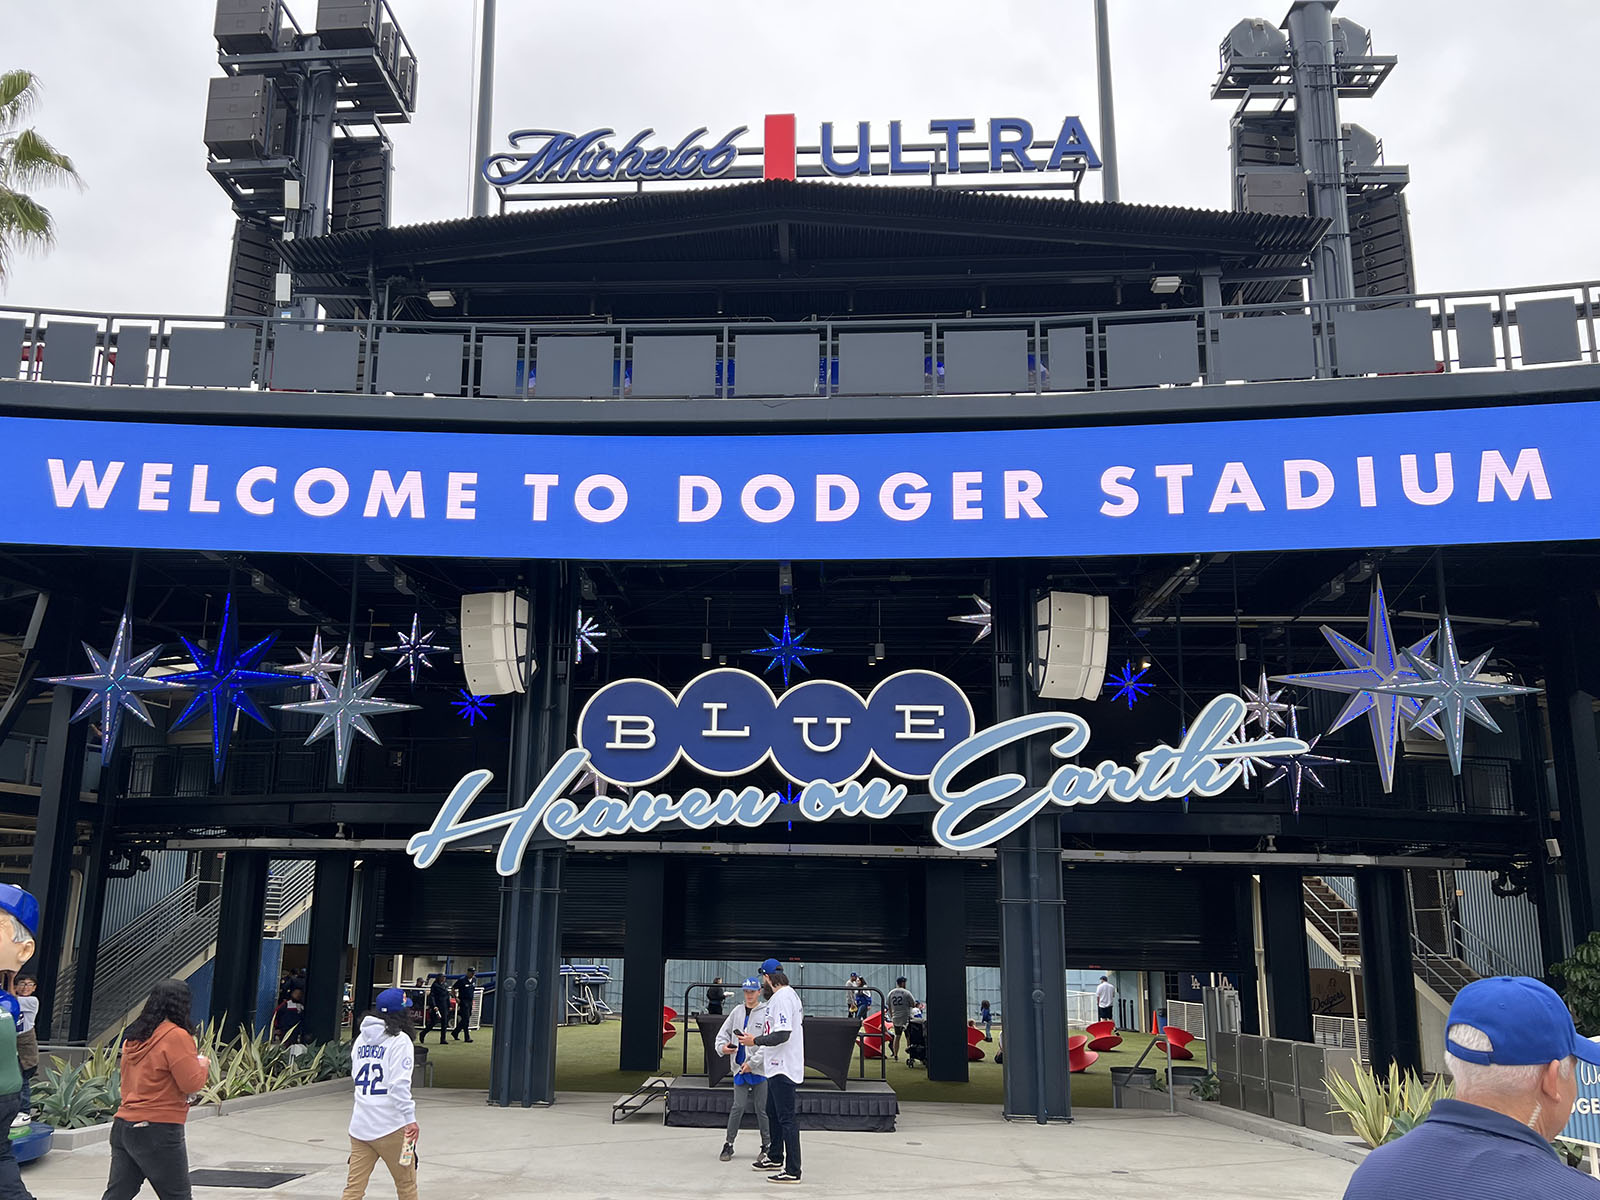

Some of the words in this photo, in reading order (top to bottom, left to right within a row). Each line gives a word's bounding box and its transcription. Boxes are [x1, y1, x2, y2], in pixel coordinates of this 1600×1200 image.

[482, 125, 749, 188] Michelob
[820, 116, 1102, 177] ULTRA
[47, 458, 477, 520] WELCOME
[524, 473, 628, 523] TO
[677, 469, 1048, 523] DODGER
[1100, 447, 1552, 517] STADIUM
[606, 702, 944, 752] BLUE
[406, 748, 780, 876] Heaven
[799, 777, 908, 822] on
[928, 693, 1310, 851] Earth
[355, 1063, 388, 1096] 42
[357, 1044, 386, 1060] ROBINSON
